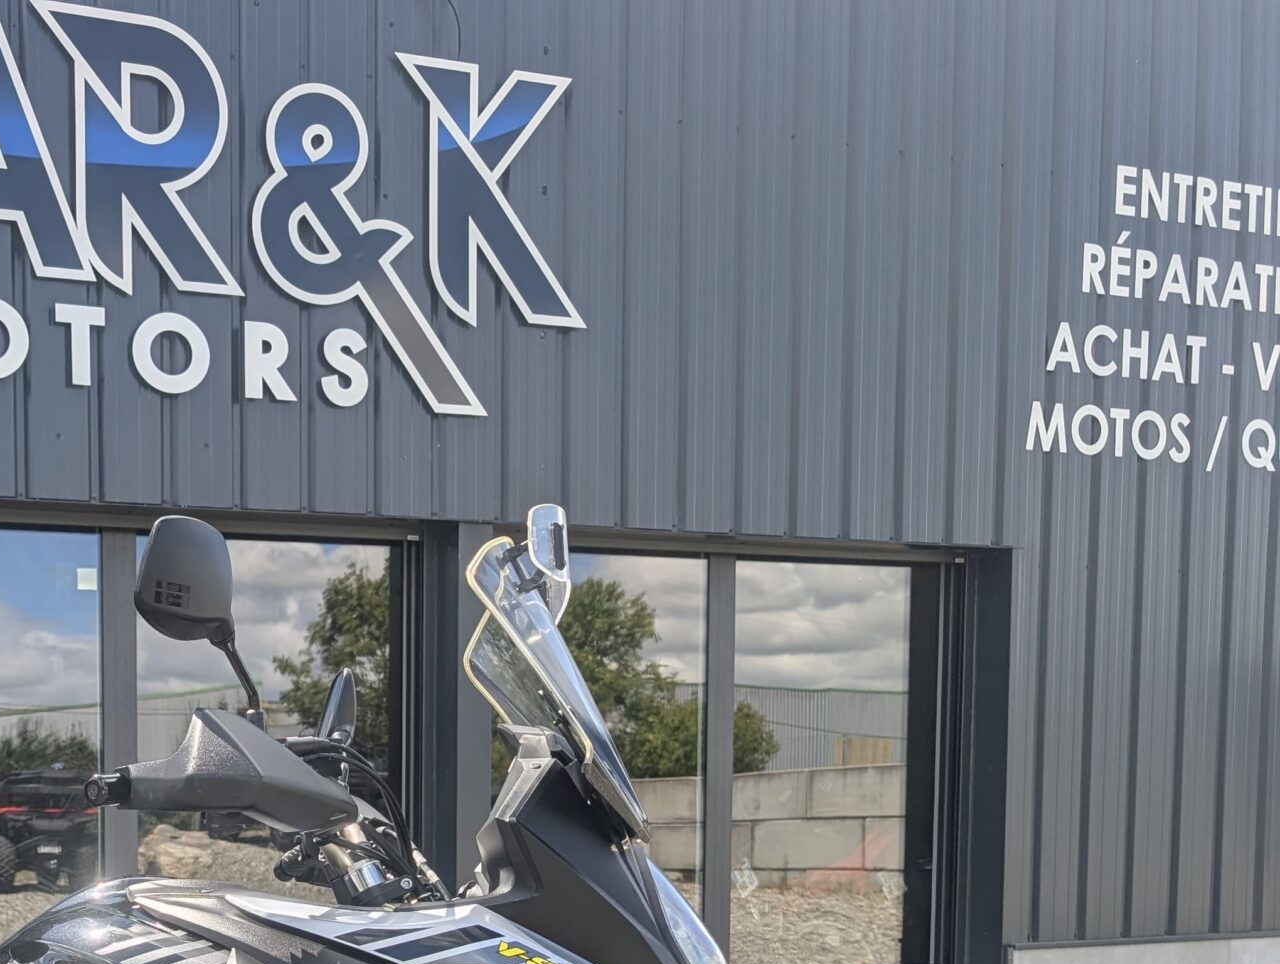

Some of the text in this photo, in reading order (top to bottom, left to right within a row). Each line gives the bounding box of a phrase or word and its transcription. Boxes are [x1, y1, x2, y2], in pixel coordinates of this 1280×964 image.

[1115, 165, 1280, 237] ENTRETI
[1046, 322, 1206, 384] ACHAT
[1026, 401, 1191, 463] MOTOS
[1206, 415, 1228, 472] /
